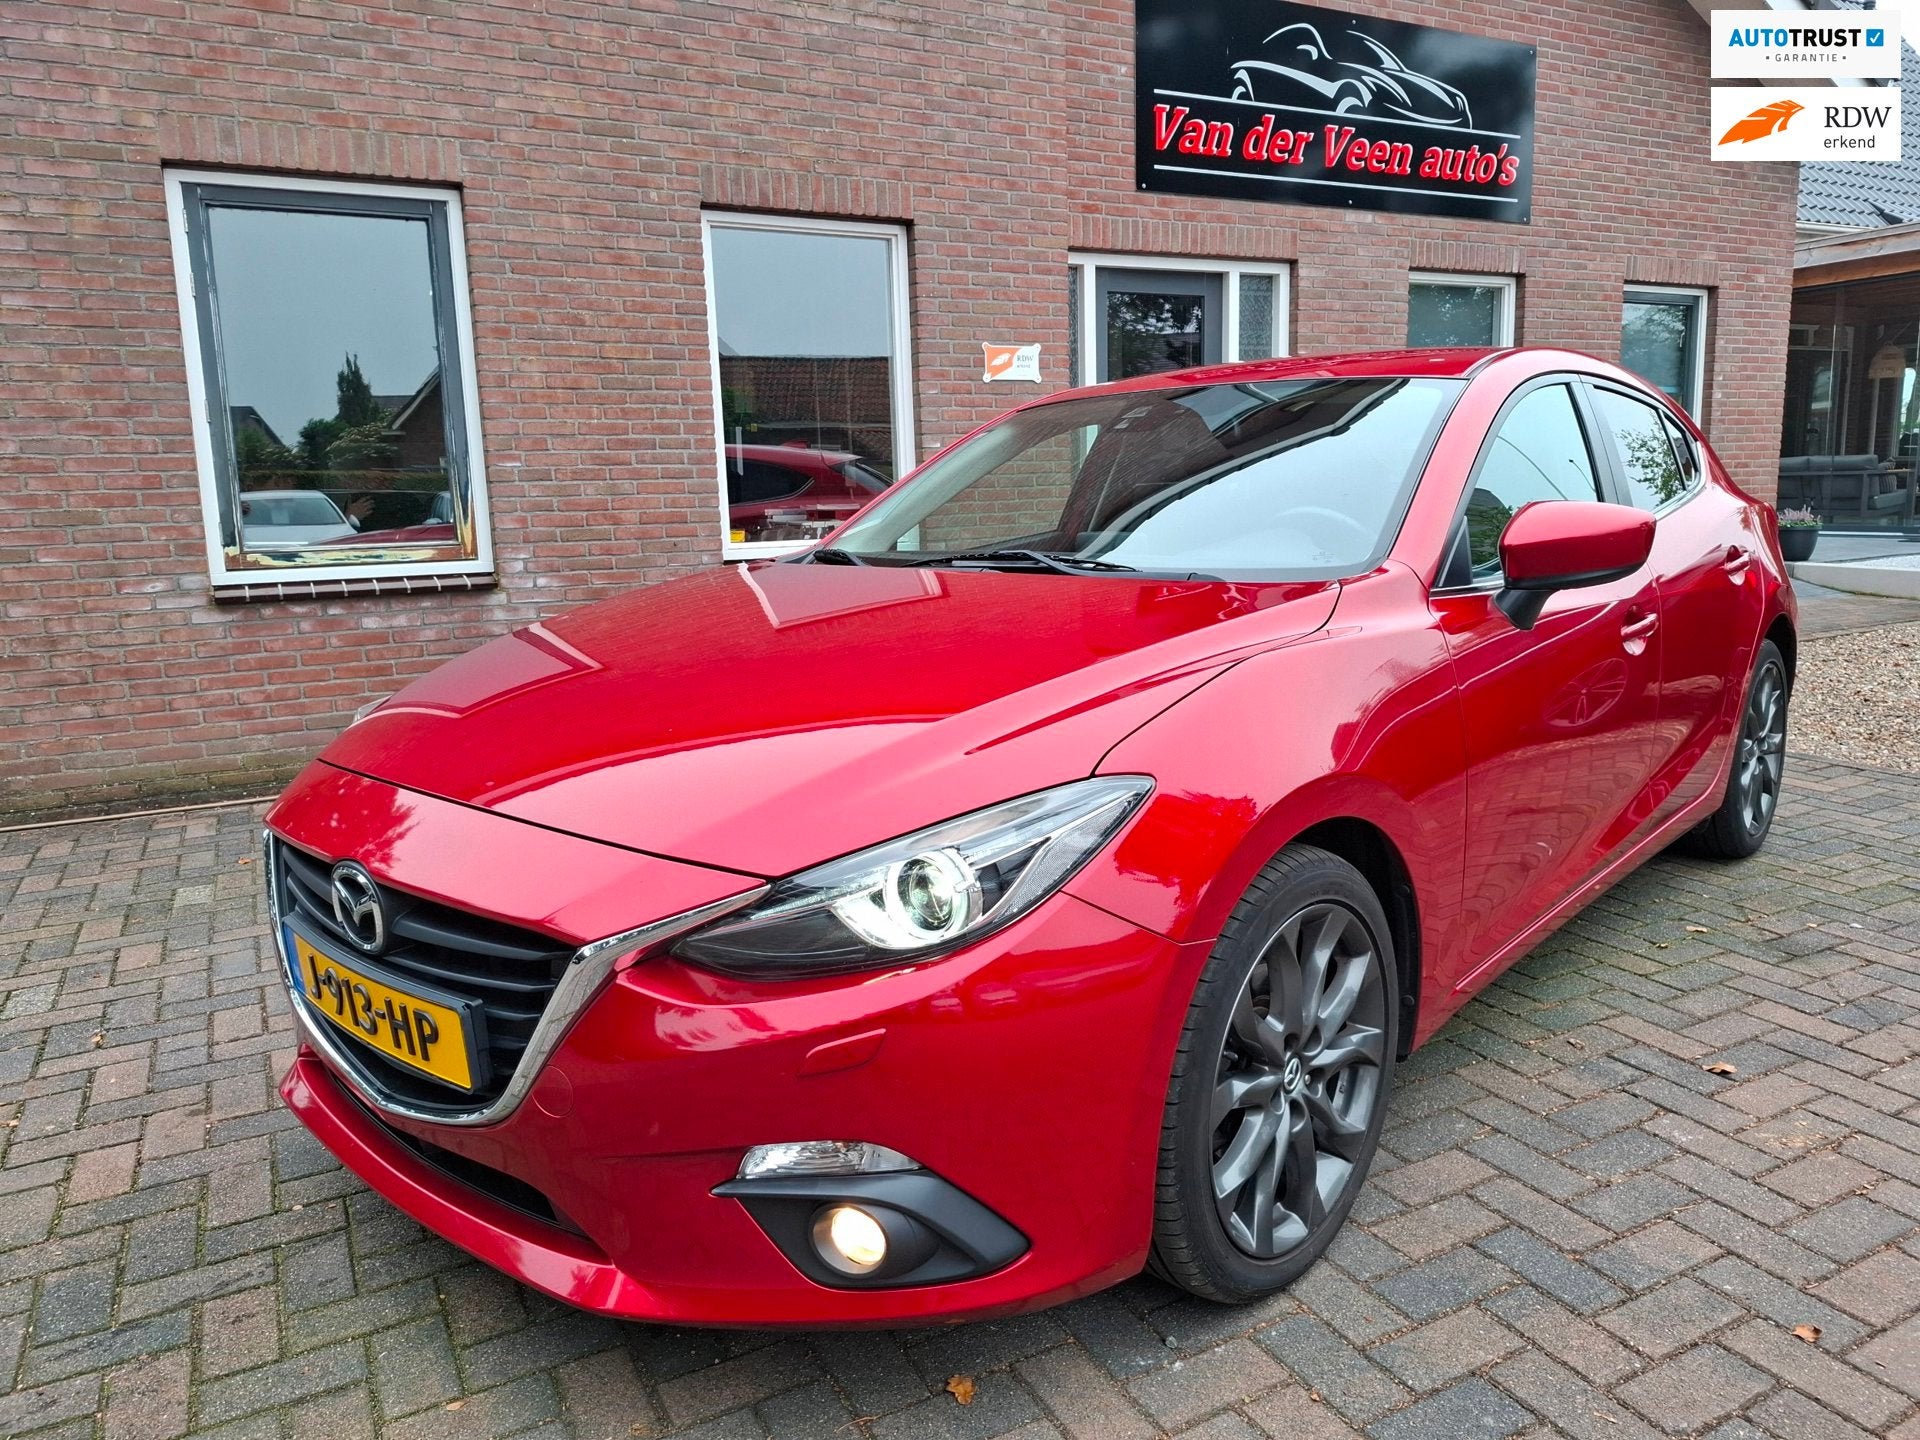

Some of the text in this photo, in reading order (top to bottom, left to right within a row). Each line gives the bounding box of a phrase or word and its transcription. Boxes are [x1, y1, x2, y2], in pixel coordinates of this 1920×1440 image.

[1153, 104, 1521, 186] Van der Veen auto's
[308, 953, 439, 1062] J-913-HP
